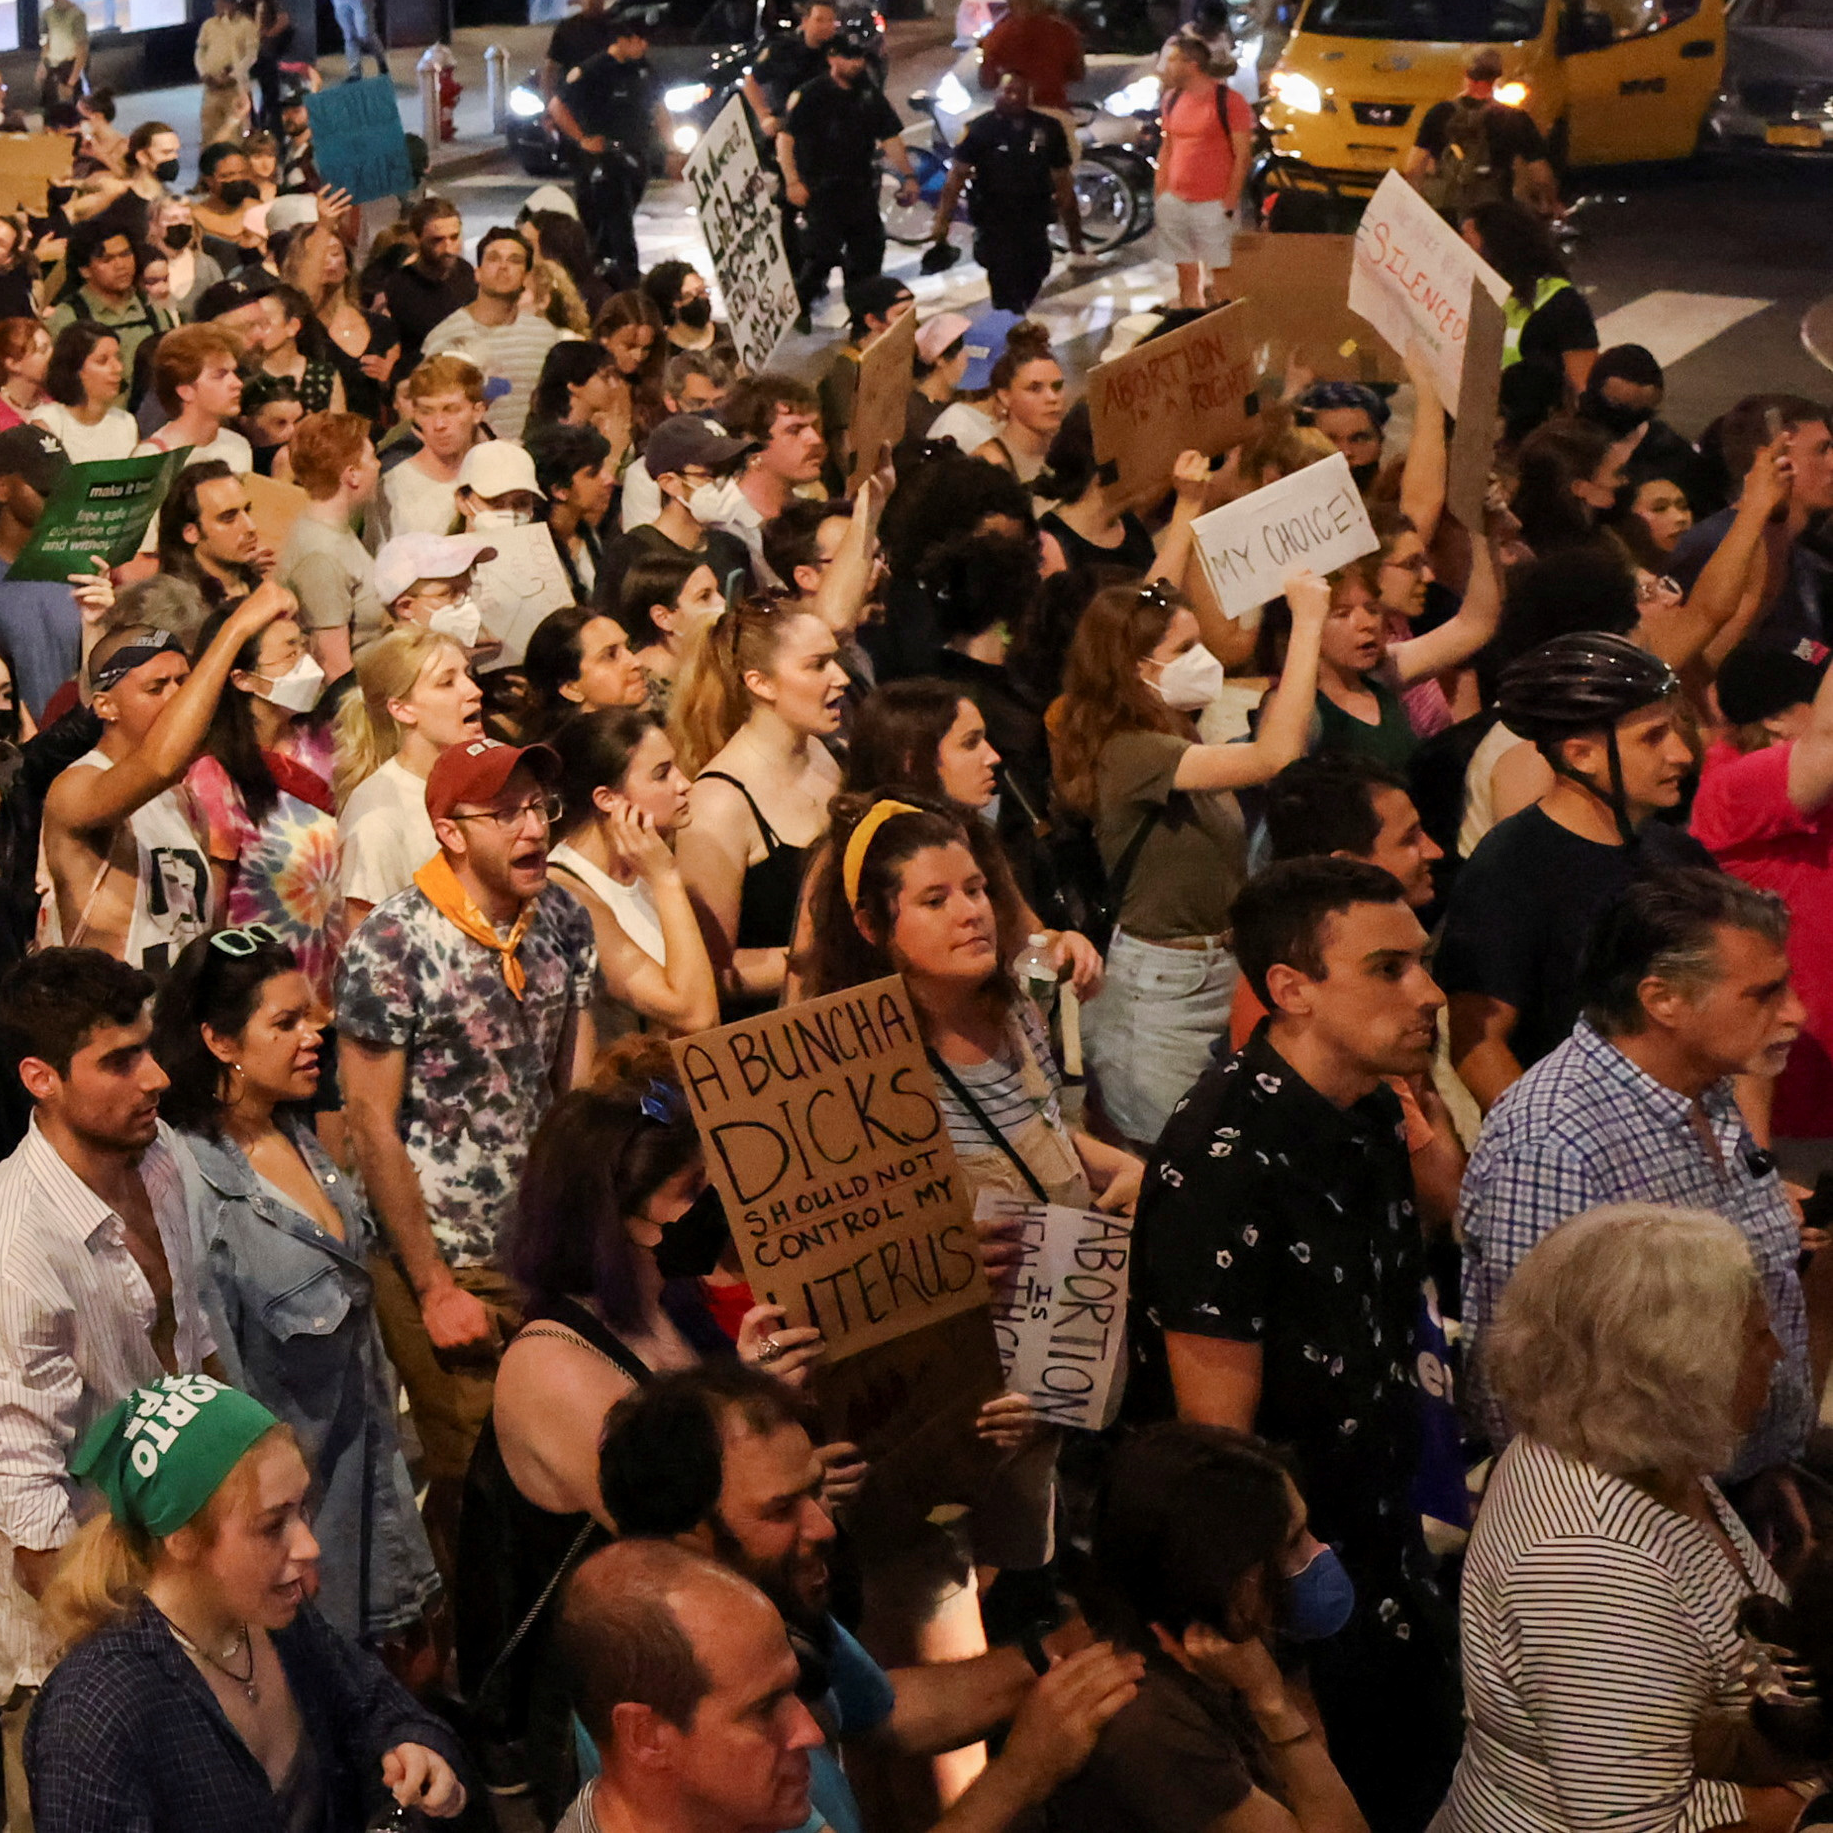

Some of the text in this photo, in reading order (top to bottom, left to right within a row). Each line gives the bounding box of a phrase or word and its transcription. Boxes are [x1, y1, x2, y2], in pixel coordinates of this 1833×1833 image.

[1210, 490, 1363, 586] MY CHOICE!
[681, 992, 914, 1113] A BUNCHA
[710, 1066, 941, 1207] DICKS
[742, 1148, 939, 1235] SHOULD NOT
[752, 1174, 955, 1269] CONTROL MY
[763, 1223, 978, 1343] UTERUS
[1031, 1284, 1052, 1321] IS
[1032, 1215, 1132, 1424] ABORTION
